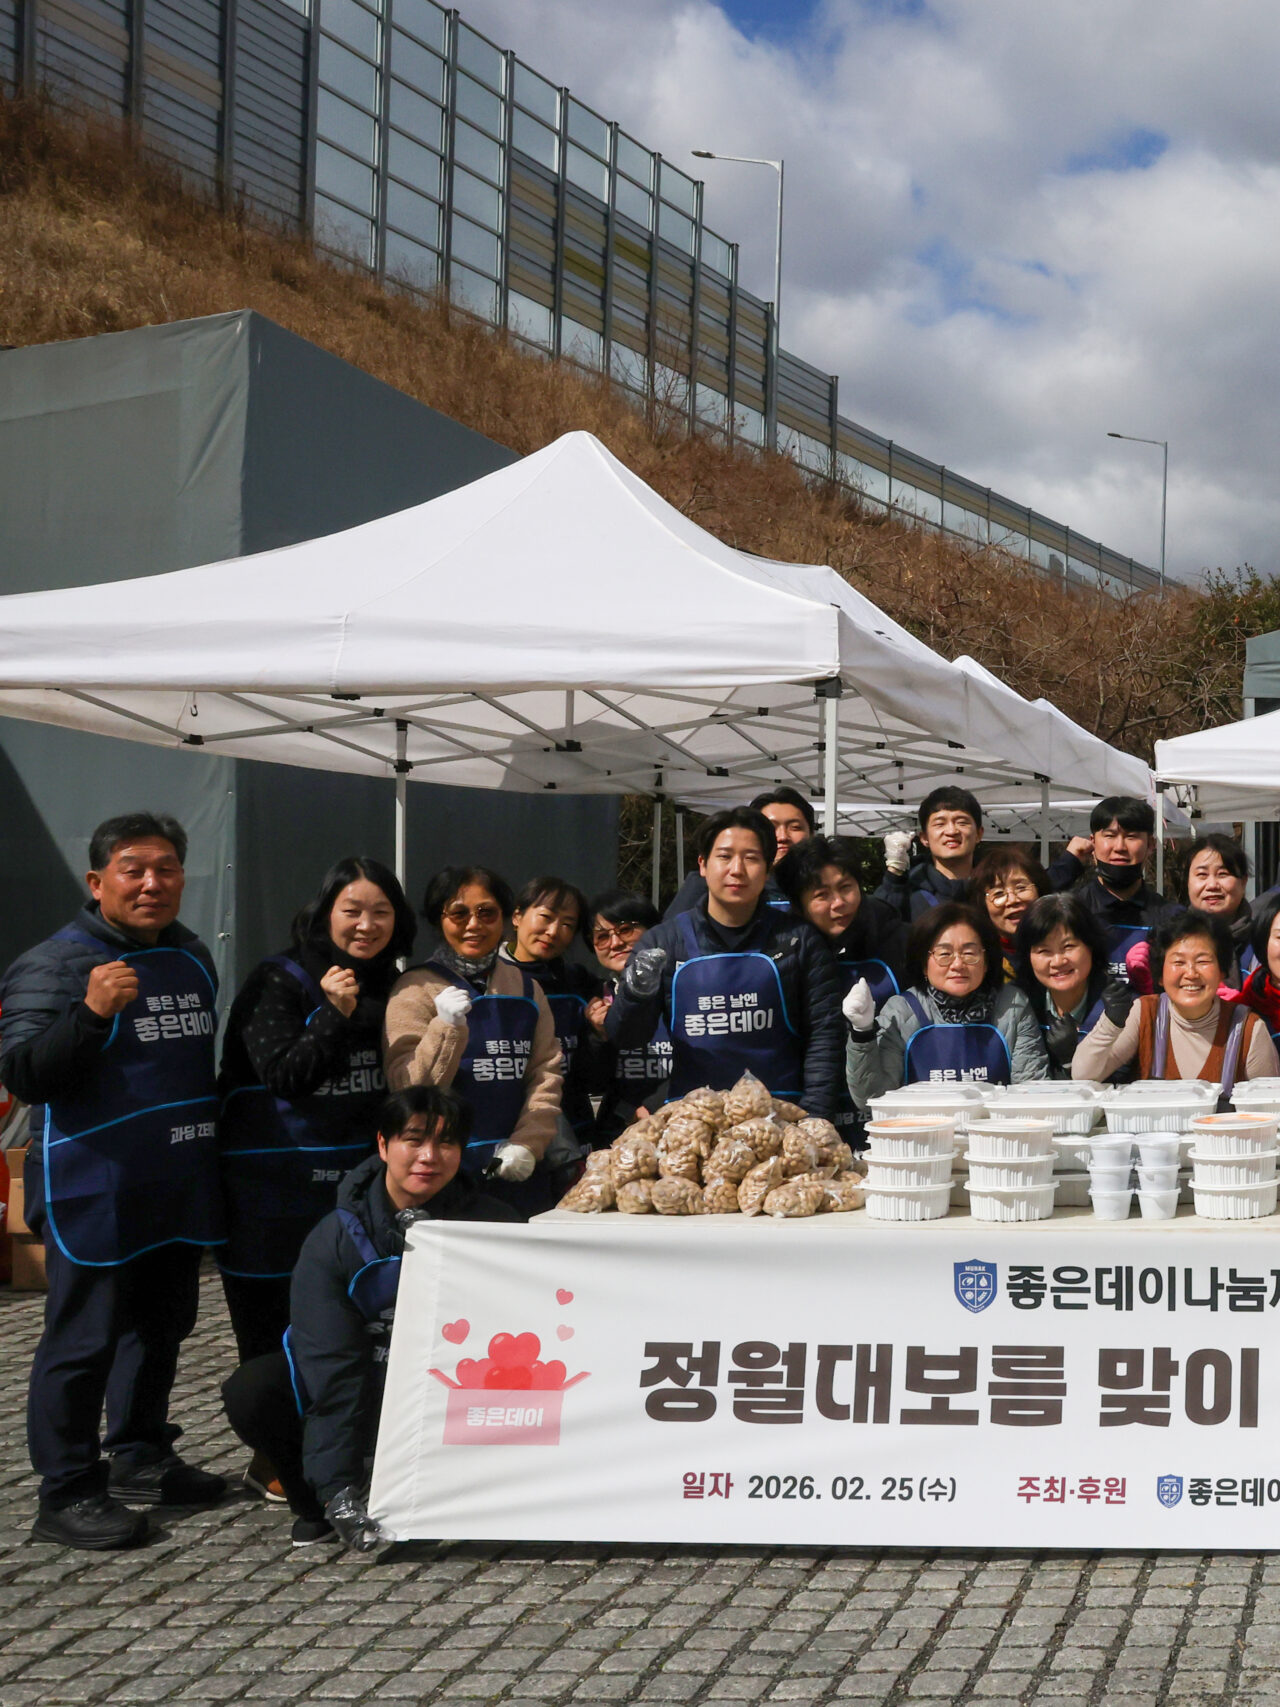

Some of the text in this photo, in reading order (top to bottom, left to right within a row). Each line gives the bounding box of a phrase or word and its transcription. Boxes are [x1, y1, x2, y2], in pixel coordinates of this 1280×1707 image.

[145, 993, 201, 1012] 좋은 날엔
[697, 992, 758, 1011] 좋은 날엔
[133, 1011, 214, 1042] 좋은데이
[684, 1008, 774, 1037] 좋은데이
[485, 1040, 510, 1055] 좋은
[961, 1067, 988, 1082] 날엔
[639, 1341, 1067, 1427] 정월대보름
[1098, 1347, 1260, 1428] 맞이
[466, 1406, 544, 1428] 좋은데이
[682, 1472, 957, 1503] 일자 2026. 02. 25(수)
